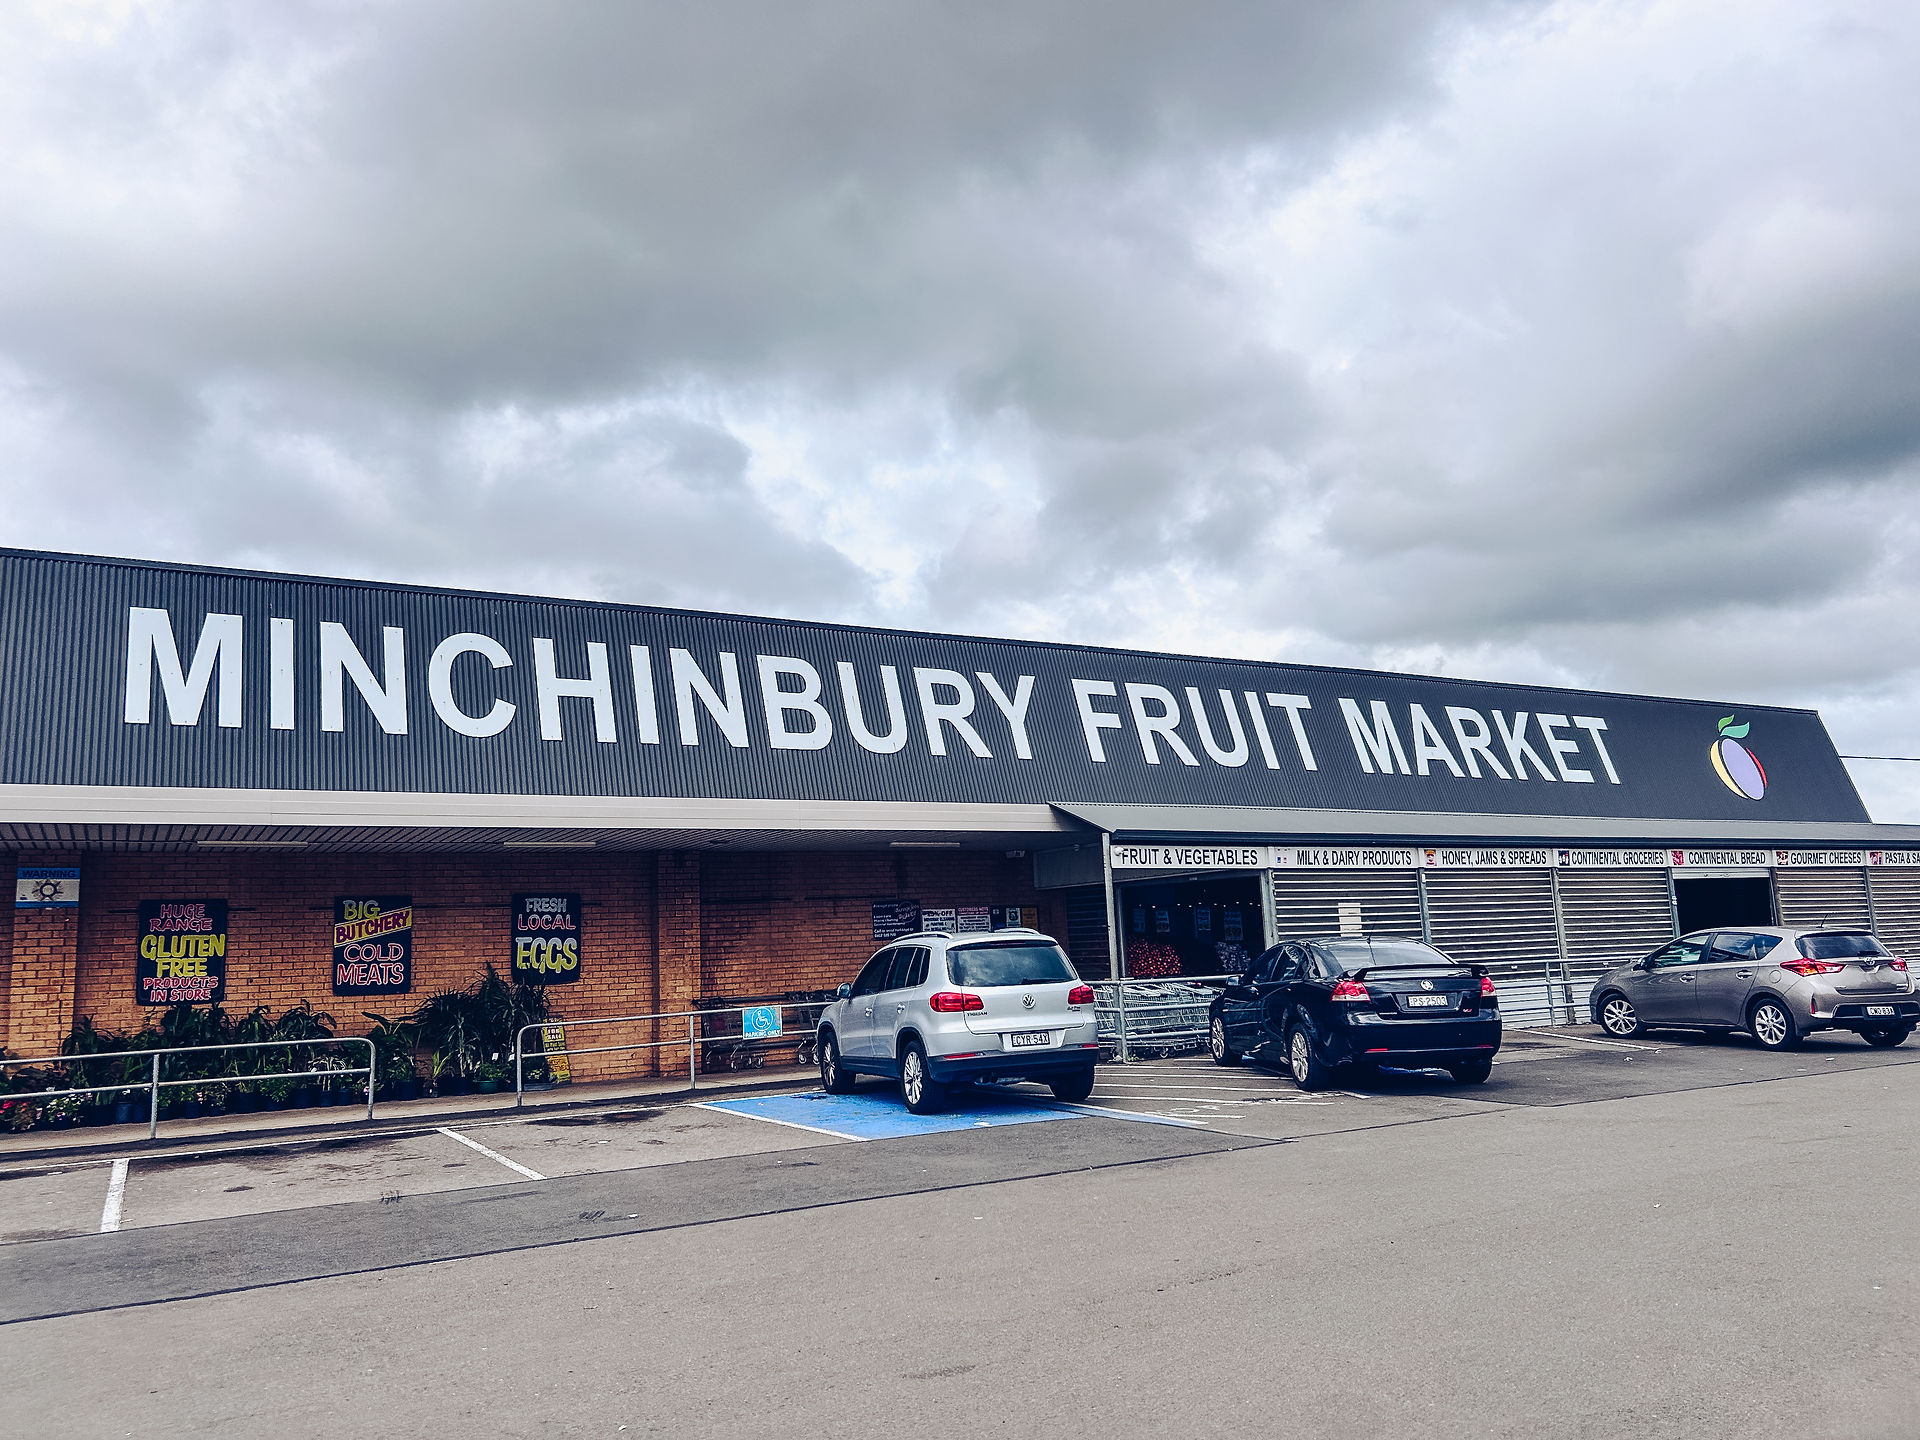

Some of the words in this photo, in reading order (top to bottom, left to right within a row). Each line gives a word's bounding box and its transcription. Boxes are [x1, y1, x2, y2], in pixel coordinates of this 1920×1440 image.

[124, 607, 1035, 760] MINCHINBURY
[1071, 678, 1317, 772] FRUIT
[1338, 698, 1621, 785] MARKET
[1122, 849, 1160, 865] FRUIT
[1163, 849, 1173, 865] &
[1175, 849, 1258, 866] VEGETABLES
[1297, 850, 1320, 866] MILK
[1322, 850, 1329, 866] &
[1331, 850, 1360, 866] DAIRY
[1362, 850, 1412, 866] PRODUCTS
[1441, 850, 1473, 867] HONEY,
[1475, 850, 1498, 866] JAMS
[1500, 850, 1507, 865] &
[1508, 850, 1547, 866] SPREADS
[1571, 851, 1621, 865] CONTINENTAL
[1623, 851, 1664, 865] GROCERIES
[1688, 852, 1739, 865] CONTINENTAL
[1741, 852, 1766, 865] BREAD
[1790, 852, 1827, 865] GOURMET
[1829, 852, 1862, 864] CHEESES
[1885, 852, 1906, 864] PASTA
[1906, 852, 1912, 864] &
[22, 869, 76, 878] WARNING
[160, 904, 206, 919] HUGE
[342, 899, 381, 920] BIG
[525, 897, 568, 913] FRESH
[149, 917, 213, 932] RANGE
[335, 910, 410, 944] BUTCHERY
[517, 913, 577, 931] LOCAL
[140, 933, 226, 960] GLUTEN
[343, 942, 404, 962] COLD
[515, 936, 578, 974] EGGS
[155, 957, 208, 978] FREE
[336, 962, 405, 986] MEATS
[143, 976, 219, 990] PRODUCTS
[149, 989, 168, 1002] IN
[169, 988, 212, 1001] STORE
